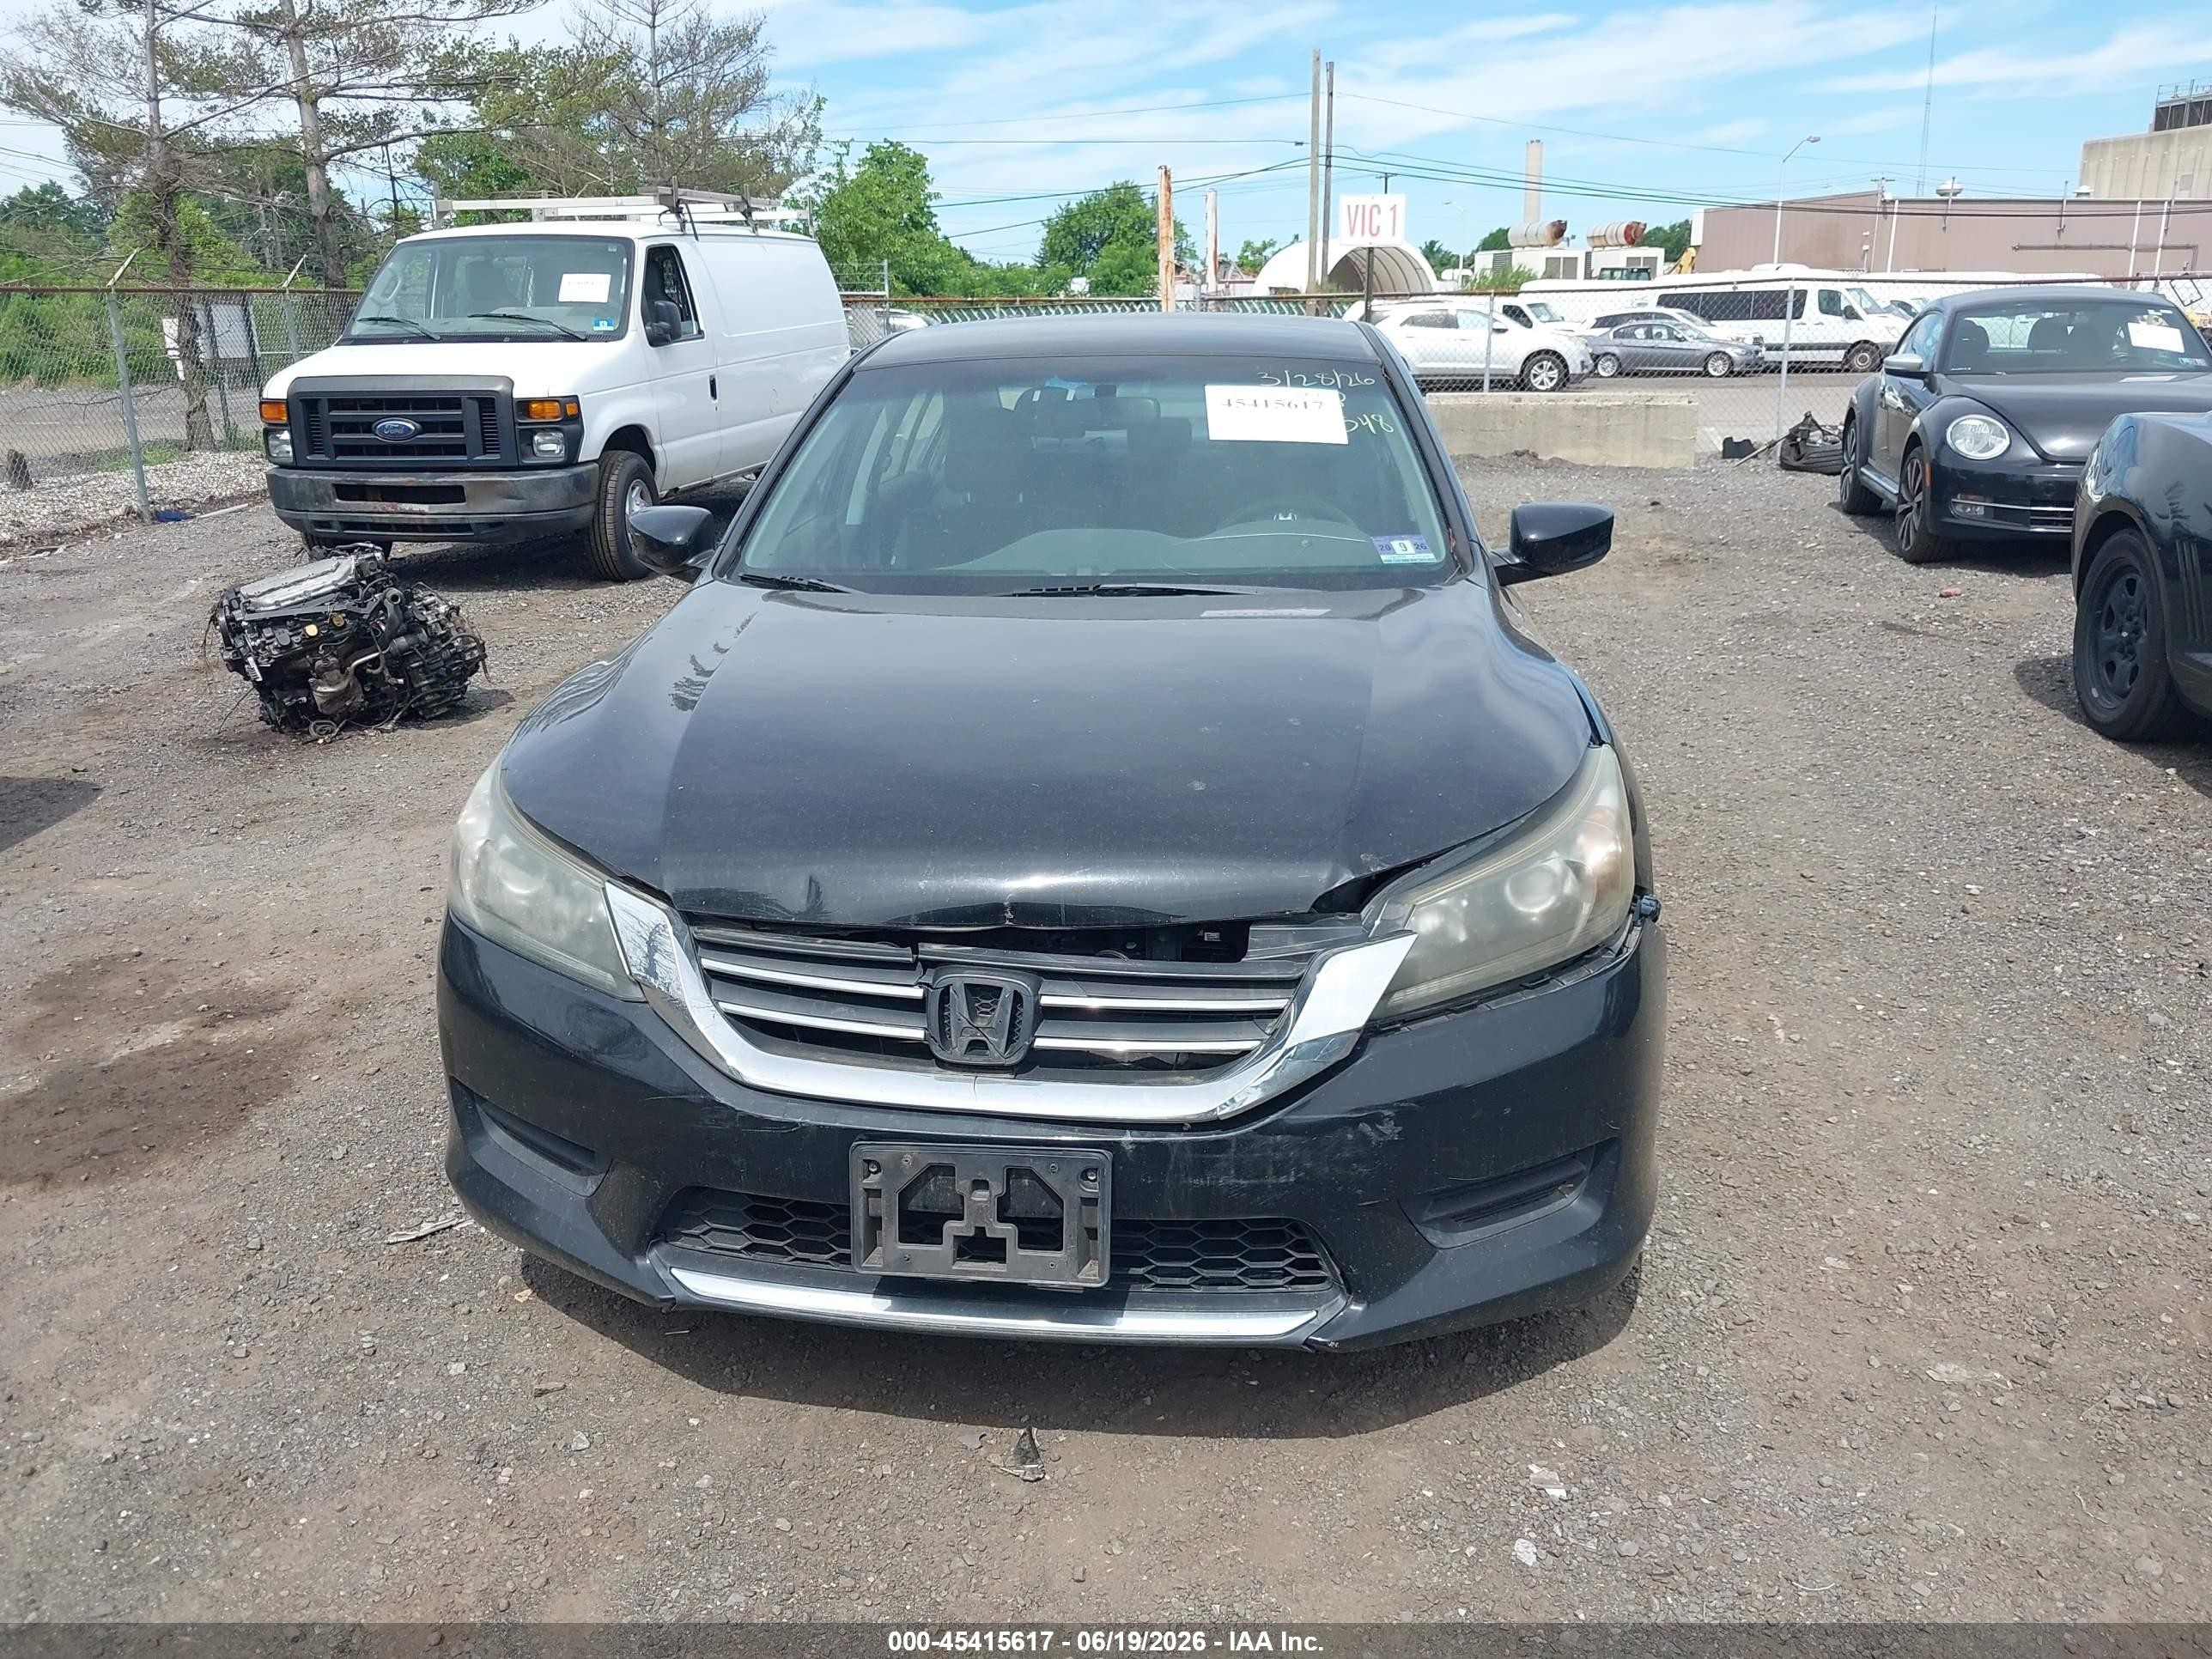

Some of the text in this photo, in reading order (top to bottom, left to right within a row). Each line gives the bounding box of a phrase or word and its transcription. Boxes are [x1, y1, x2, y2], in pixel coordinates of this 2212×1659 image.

[1346, 204, 1397, 237] VIC 1
[1399, 542, 1408, 552] 9
